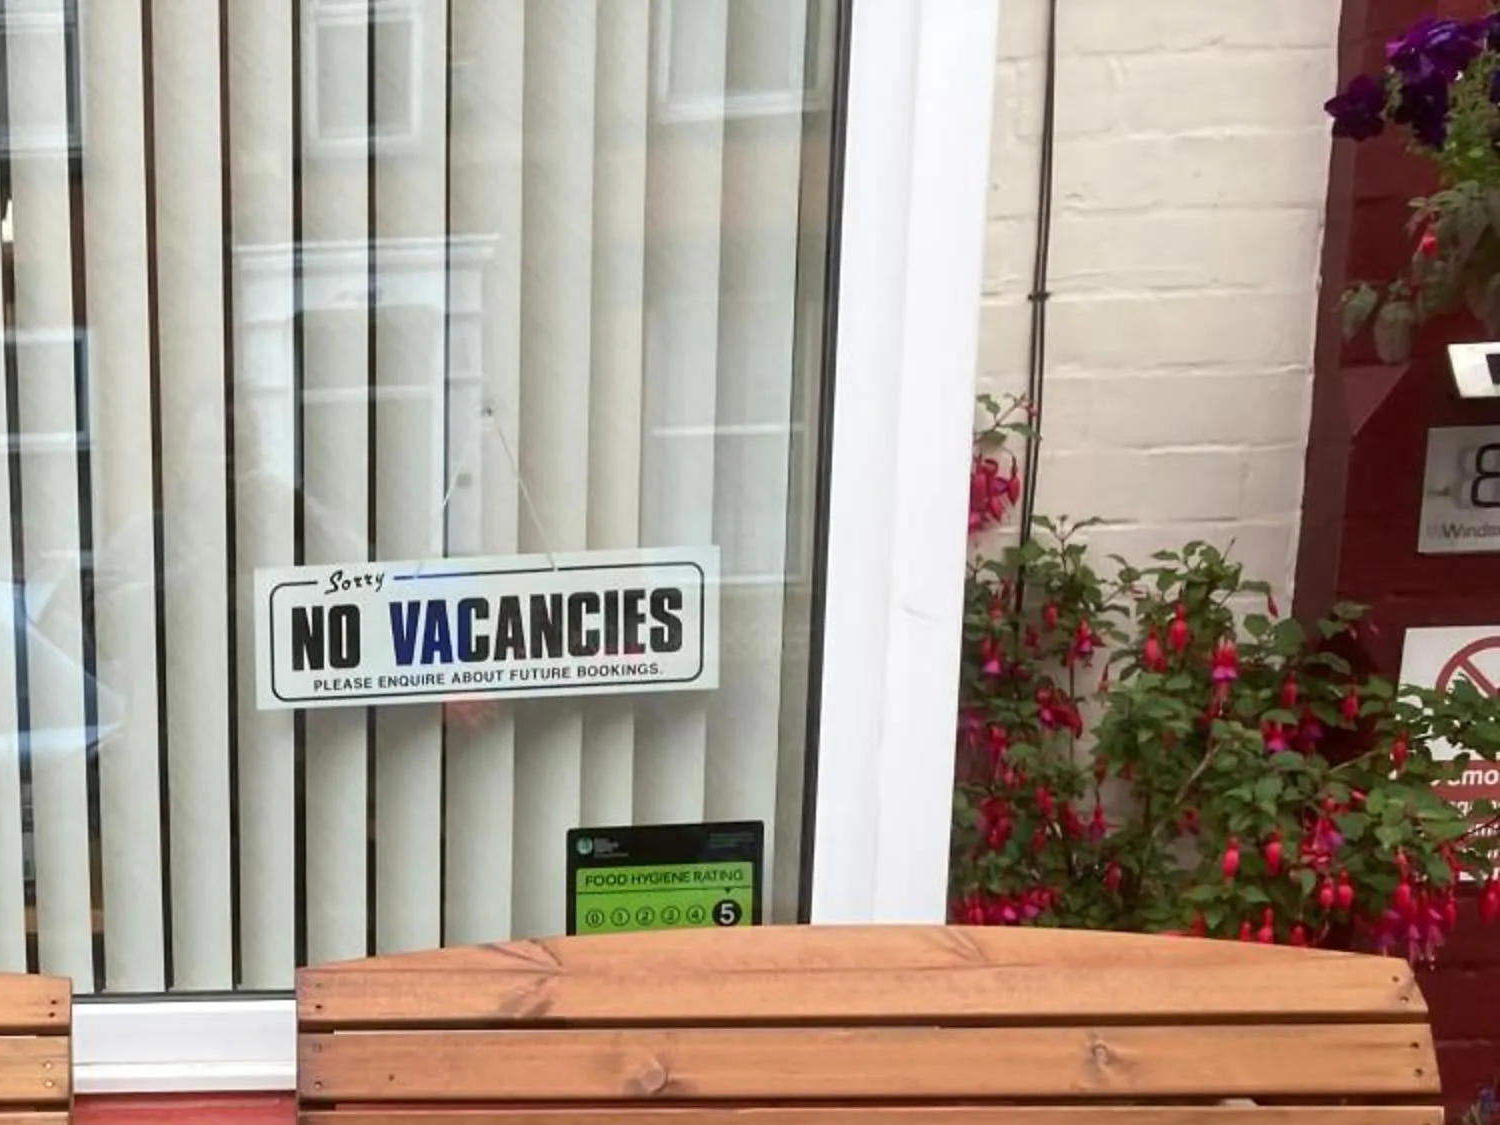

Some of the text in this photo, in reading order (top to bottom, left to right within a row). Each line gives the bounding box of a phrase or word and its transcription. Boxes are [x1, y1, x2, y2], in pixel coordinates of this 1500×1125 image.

[324, 570, 385, 594] Sorry
[292, 587, 683, 671] NO VACANCIES
[314, 677, 373, 692] PLEASE
[378, 673, 446, 688] ENQUIRE
[451, 669, 504, 684] ABOUT
[510, 666, 571, 681] FUTURE
[586, 868, 744, 886] FOOD HYGIENE RATING
[720, 903, 735, 924] 5
